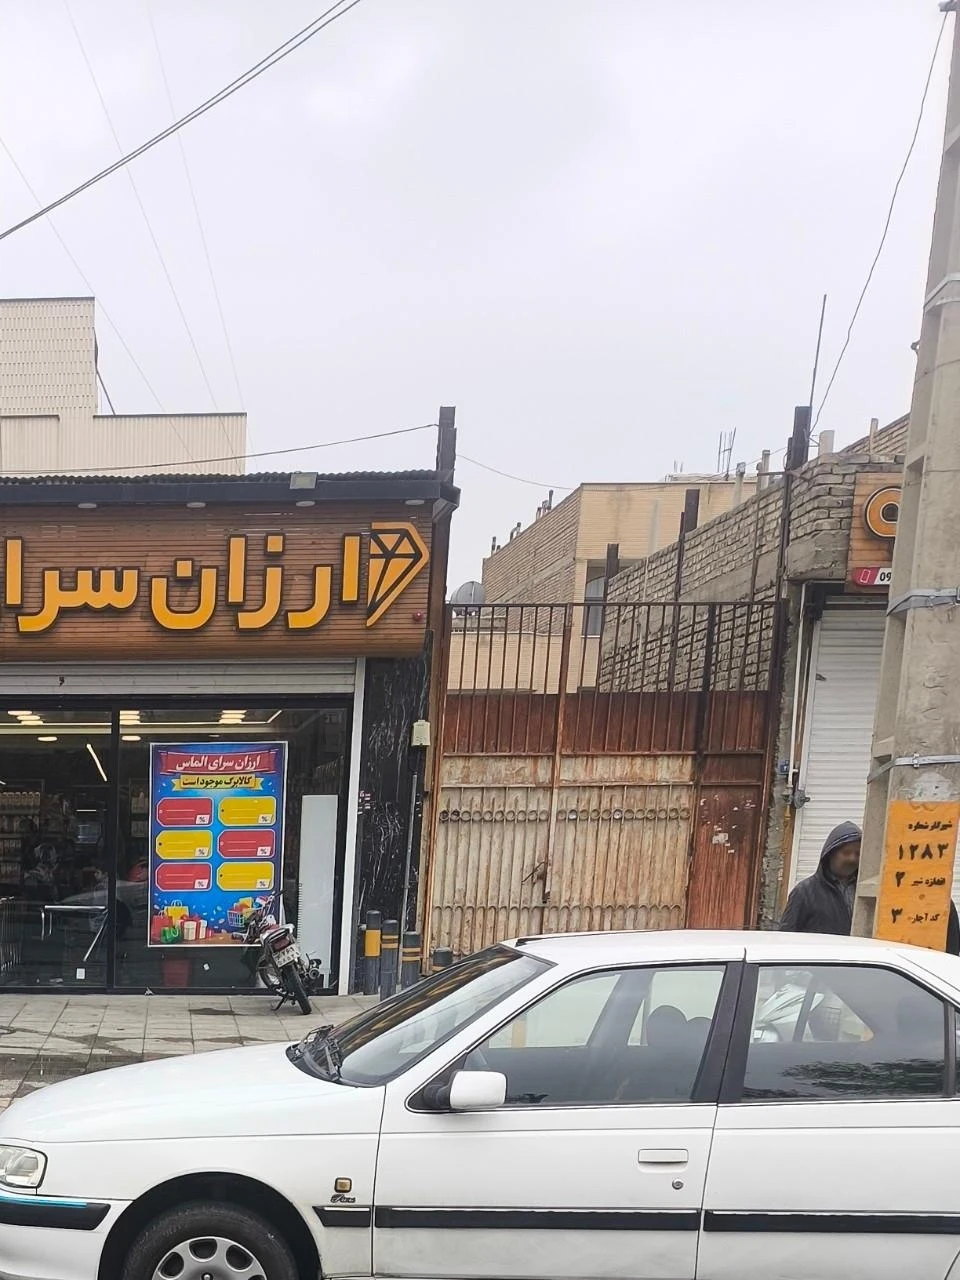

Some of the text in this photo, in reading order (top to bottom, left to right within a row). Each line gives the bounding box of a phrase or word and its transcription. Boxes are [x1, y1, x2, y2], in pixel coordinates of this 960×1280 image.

[150, 533, 359, 631] ارزان
[175, 754, 261, 771] ارزان سرای الماس
[182, 777, 200, 786] است
[199, 777, 223, 788] موجود
[891, 907, 904, 924] ۳
[929, 913, 941, 922] کد
